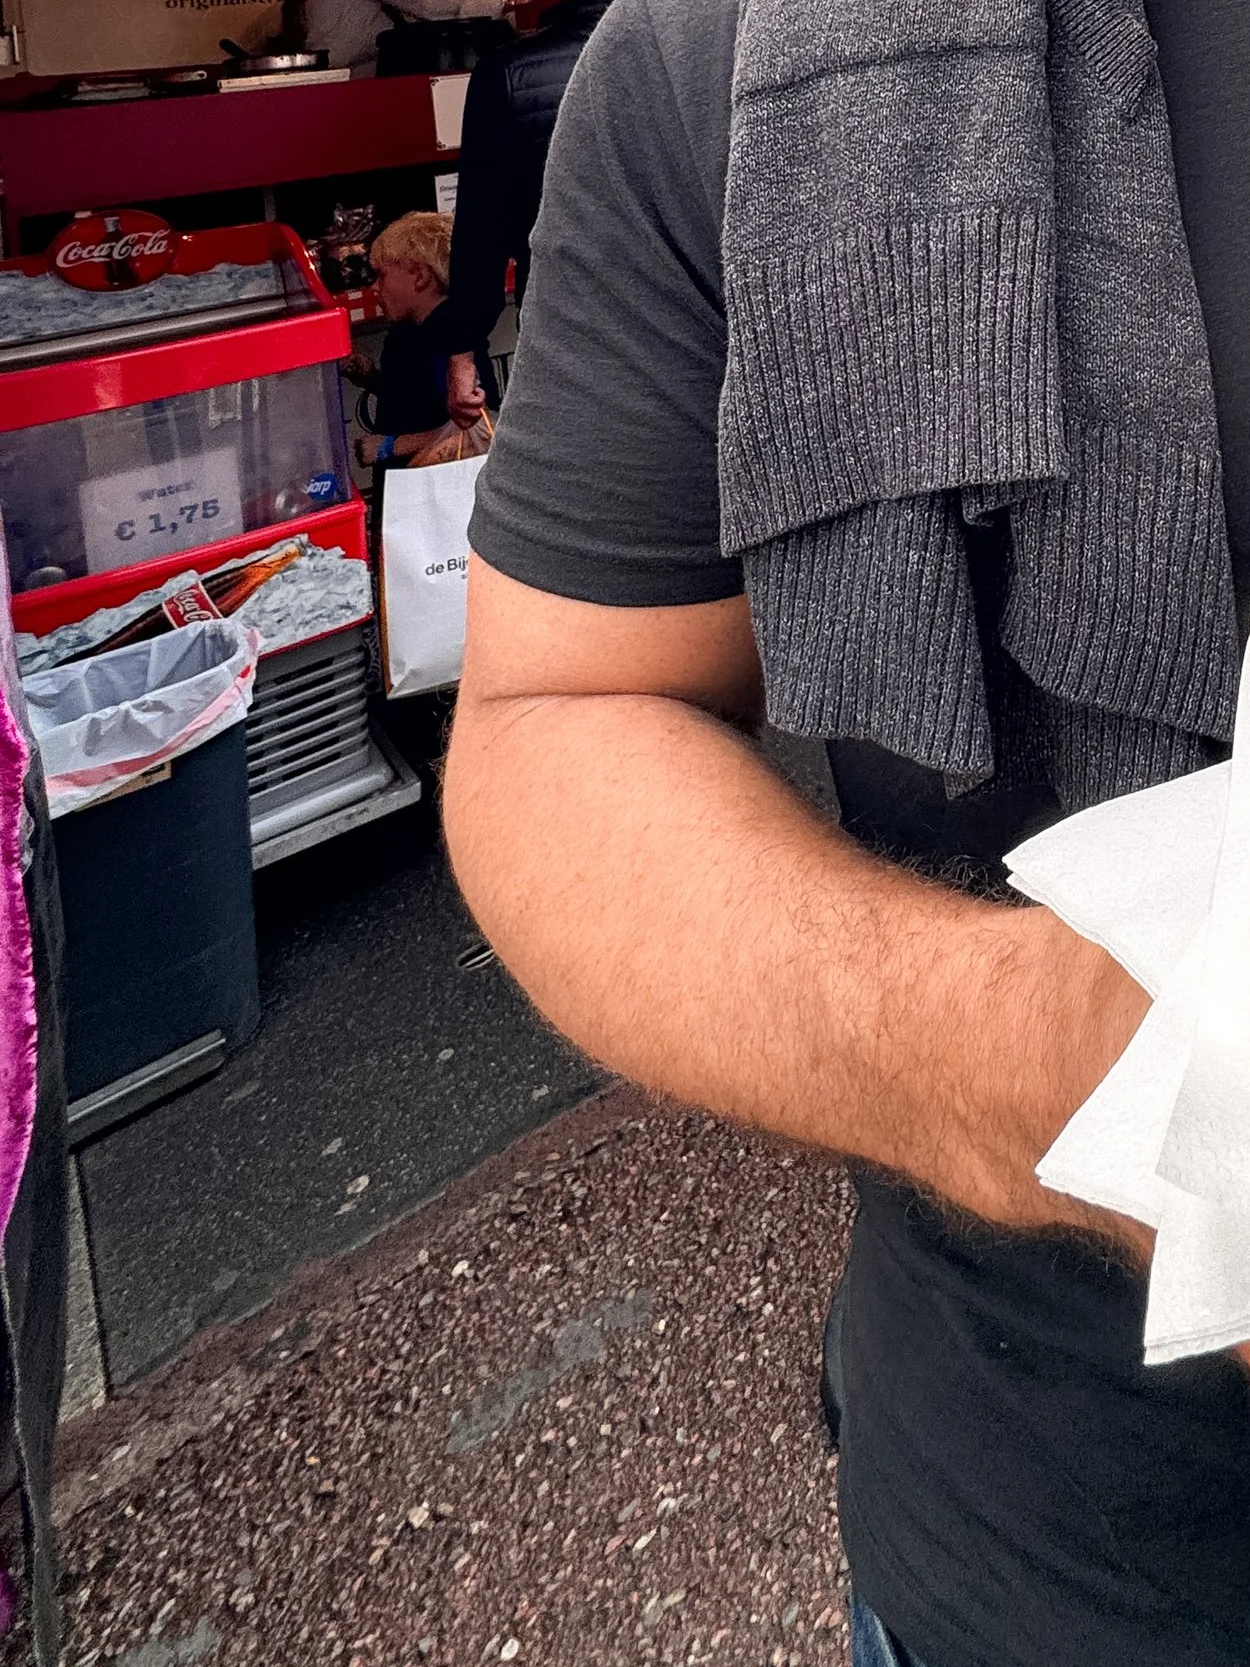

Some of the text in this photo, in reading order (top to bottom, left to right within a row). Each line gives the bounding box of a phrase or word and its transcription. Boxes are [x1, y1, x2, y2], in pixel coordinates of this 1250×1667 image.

[115, 498, 220, 541] € 1,75
[425, 556, 469, 576] de Bij
